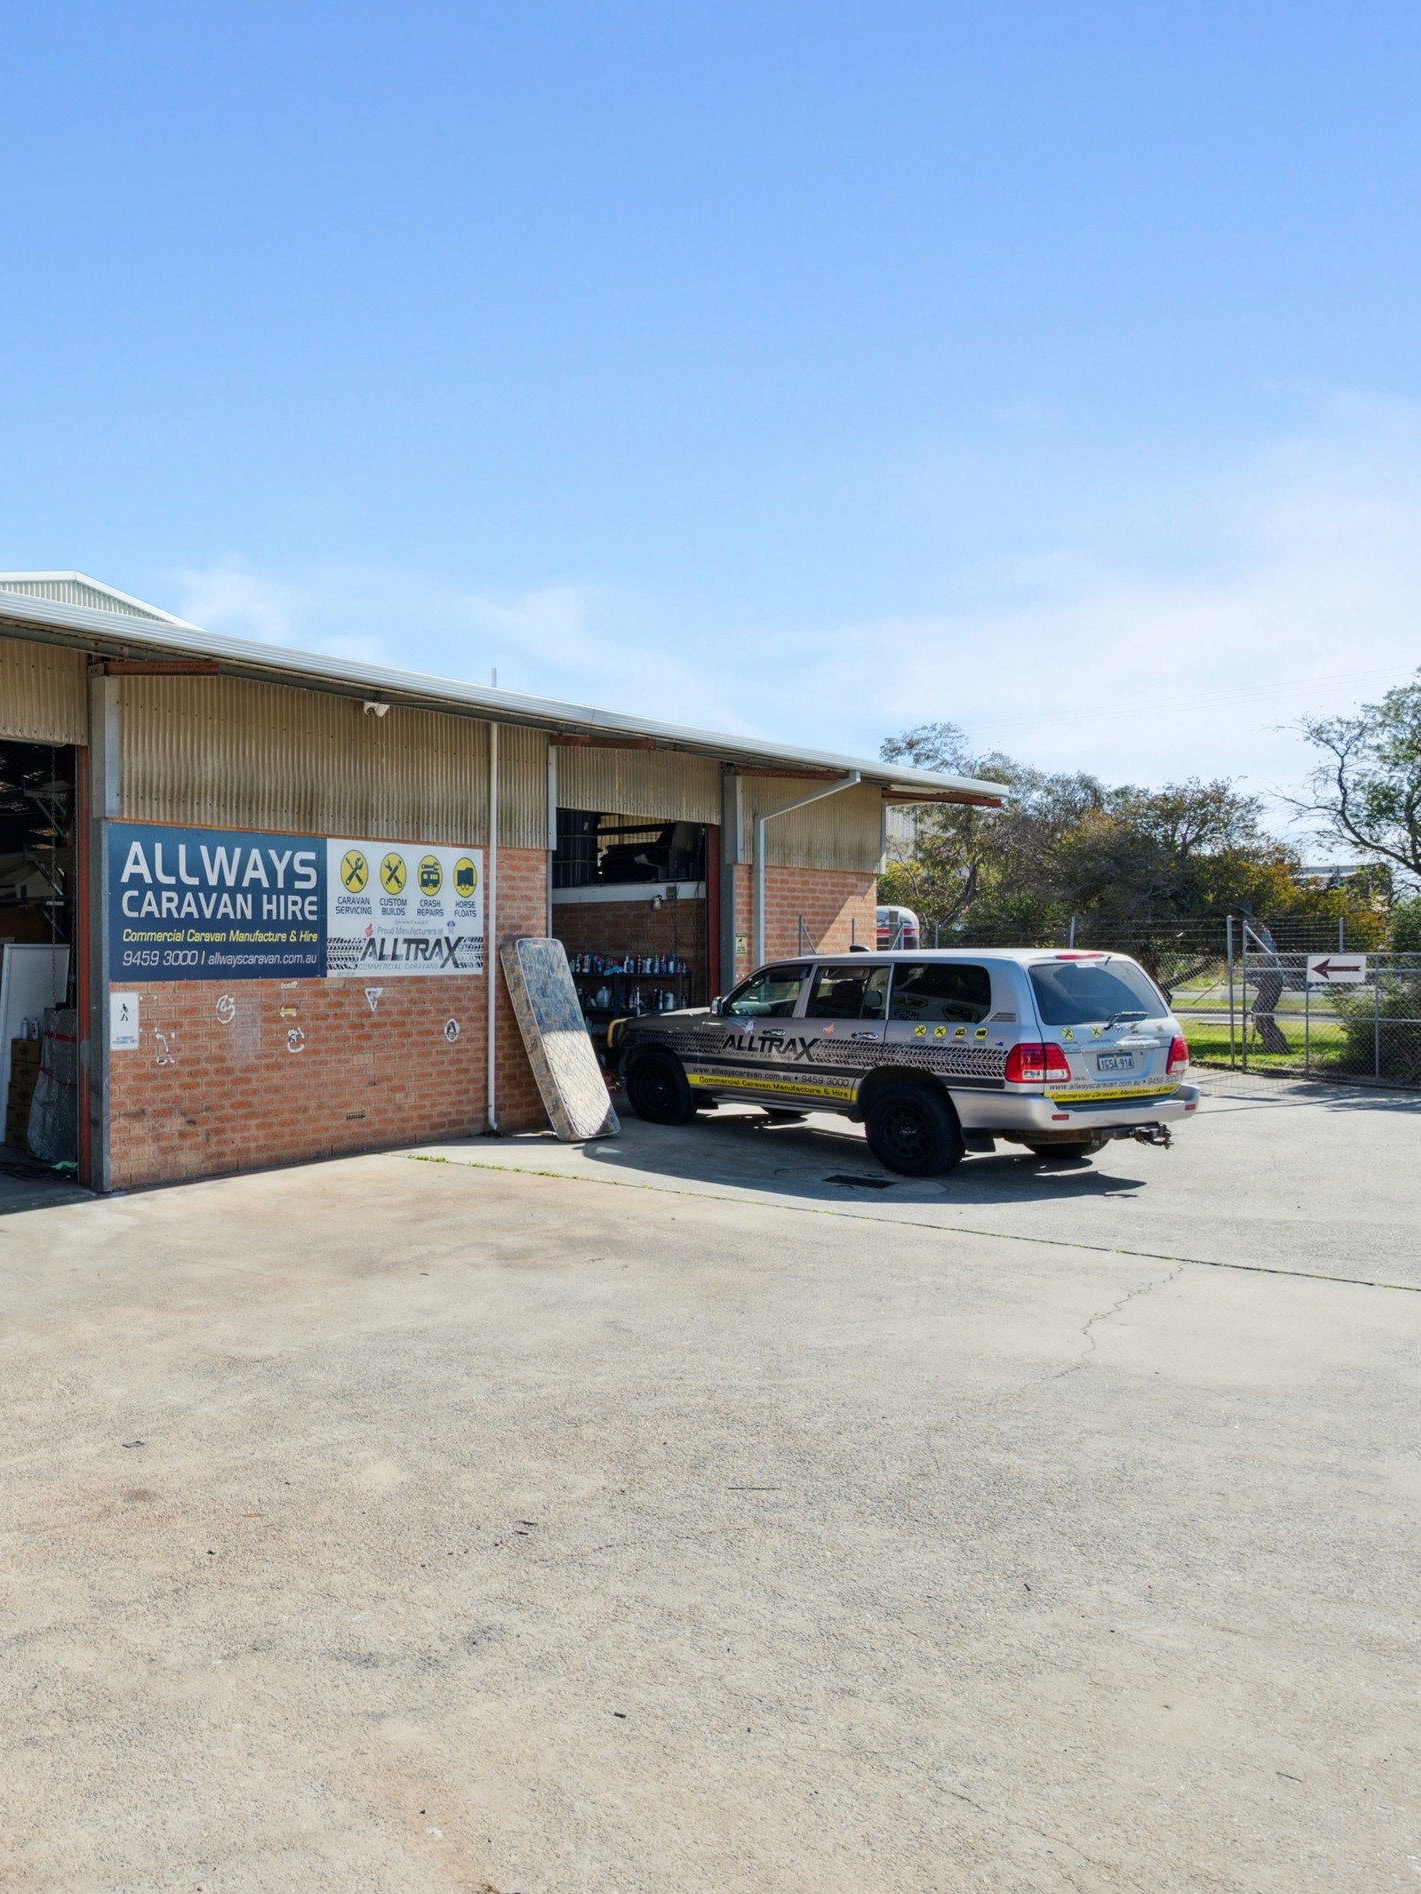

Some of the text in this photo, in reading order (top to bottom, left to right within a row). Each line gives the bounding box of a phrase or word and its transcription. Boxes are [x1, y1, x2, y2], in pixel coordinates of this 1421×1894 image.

[120, 841, 318, 889] ALLWAYS
[337, 896, 370, 905] CARAVAN
[380, 898, 407, 906] CUSTOM
[420, 899, 441, 907] CRASH
[455, 901, 475, 909] HORSE
[122, 890, 318, 921] CARAVAN HIRE
[335, 906, 372, 915] SERVICING
[382, 907, 406, 916] BUILDS
[417, 908, 444, 917] REPAIRS
[454, 909, 477, 918] FLOATS
[123, 928, 318, 942] Commercial Caravan Manufacture & Hire
[377, 926, 444, 935] Proud Manufacturers of
[360, 936, 464, 969] ALLTRAX
[123, 951, 159, 966] 9459
[163, 951, 199, 966] 3000
[208, 952, 317, 968] allwayscaravan.com.au
[722, 1035, 821, 1062] ALLTRAX
[720, 1050, 758, 1058] COMMERCIAL
[693, 1066, 849, 1087] www.allwayscaravan.com.au 9459 3000
[699, 1076, 741, 1086] Commercial
[742, 1080, 771, 1089] Caravan
[773, 1083, 821, 1094] Manufacture
[832, 1089, 849, 1097] Hire
